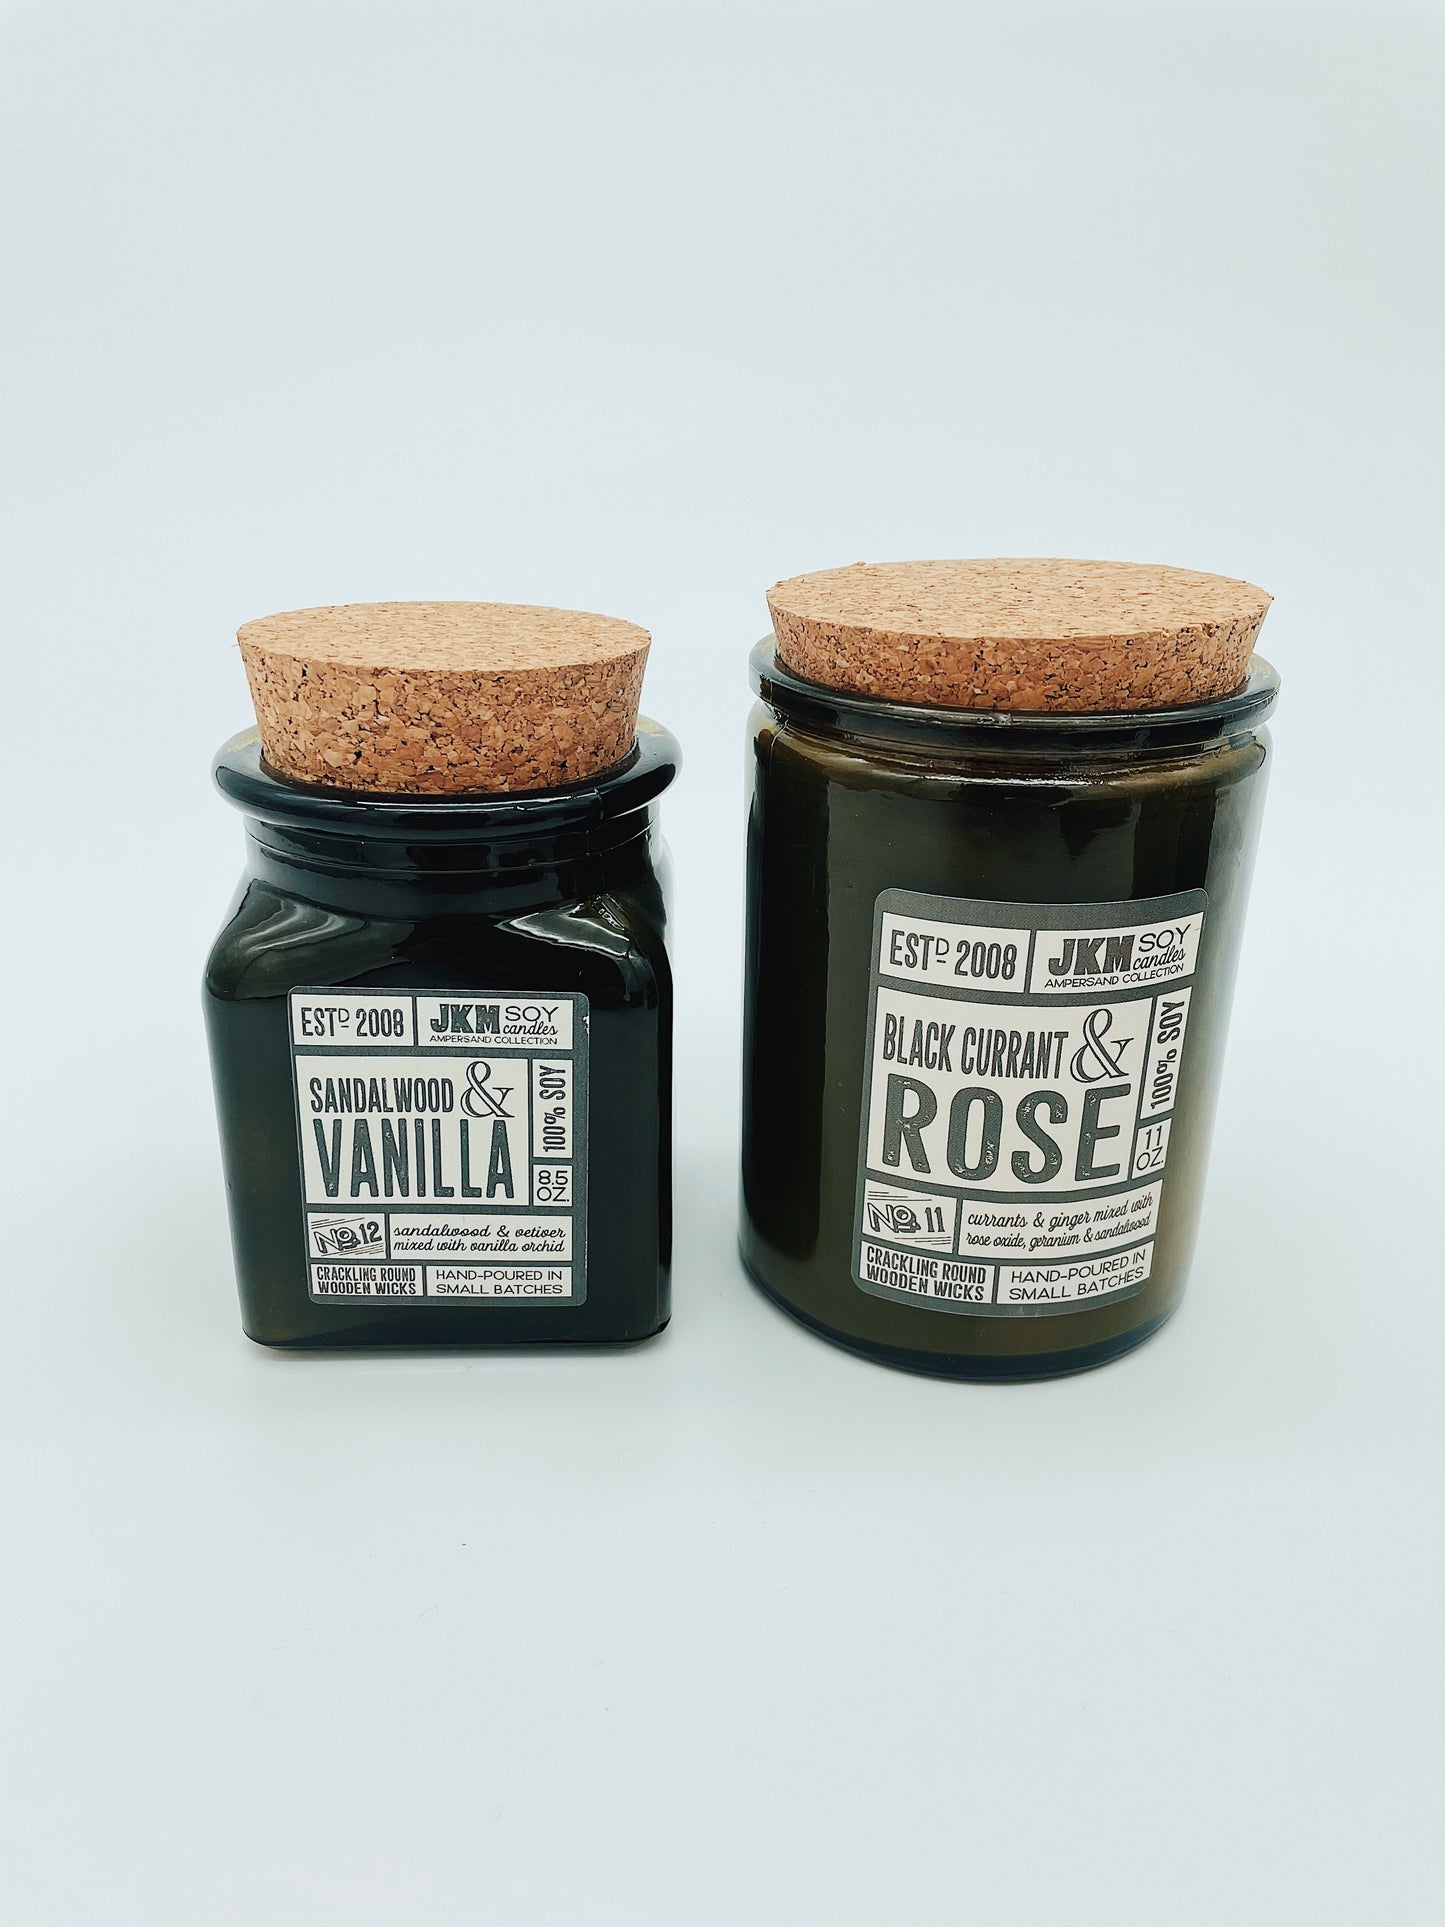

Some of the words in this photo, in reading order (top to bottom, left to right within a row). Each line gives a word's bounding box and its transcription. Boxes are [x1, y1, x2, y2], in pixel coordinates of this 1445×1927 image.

[1138, 924, 1191, 951] SOY
[955, 942, 1017, 980] 2008
[1049, 935, 1135, 975] JKM
[1132, 945, 1186, 970] candles
[1044, 975, 1119, 988] AMPERSAND
[1123, 964, 1183, 983] COLLECTION
[356, 1008, 404, 1037] 2008
[430, 1004, 500, 1034] JKM
[505, 1006, 559, 1022] SOY
[1157, 1001, 1184, 1044] SOY
[430, 1035, 492, 1044] AMPERSAND
[494, 1036, 558, 1045] COLLECTION
[502, 1021, 558, 1036] candles
[883, 1014, 956, 1072] BLACK
[961, 1027, 1068, 1079] CURRANT
[1070, 1009, 1134, 1083] &
[310, 1077, 453, 1113] SANDALWOOD
[460, 1061, 514, 1118] &
[540, 1066, 566, 1100] SOY
[1151, 1049, 1177, 1109] 100%
[543, 1107, 566, 1152] 100%
[882, 1073, 1131, 1184] ROSE
[1146, 1126, 1162, 1149] 11
[313, 1118, 514, 1198] VANILLA
[1137, 1149, 1163, 1170] OZ.
[538, 1170, 568, 1186] 8.5
[536, 1188, 570, 1202] OZ.
[925, 1207, 945, 1233] 11
[968, 1212, 1027, 1227] currants
[1033, 1213, 1045, 1227] &
[1050, 1212, 1091, 1232] ginger
[1093, 1205, 1127, 1222] mixed
[1131, 1192, 1153, 1212] with
[360, 1221, 382, 1245] 12
[394, 1224, 491, 1237] sandalwood
[497, 1226, 510, 1237] &
[516, 1227, 566, 1238] vetiver
[966, 1233, 991, 1246] rose
[993, 1233, 1026, 1249] oxide,
[1029, 1232, 1081, 1251] geranium
[1083, 1228, 1093, 1242] &
[1094, 1212, 1152, 1241] sandalwood
[394, 1239, 434, 1251] mixed
[436, 1239, 467, 1251] with
[470, 1240, 517, 1252] vanilla
[521, 1240, 564, 1252] orchid
[317, 1267, 376, 1281] CRACKLING
[380, 1268, 415, 1282] ROUND
[437, 1270, 542, 1280] HAND-POURED
[548, 1271, 562, 1280] IN
[867, 1246, 939, 1279] CRACKLING
[943, 1264, 985, 1284] ROUND
[1011, 1257, 1129, 1283] HAND-POURED
[1133, 1250, 1145, 1269] IN
[318, 1281, 371, 1294] WOODEN
[375, 1283, 416, 1294] WICKS
[437, 1284, 489, 1294] SMALL
[494, 1285, 562, 1294] BATCHES
[867, 1264, 927, 1293] WOODEN
[935, 1282, 984, 1301] WICKS
[1009, 1288, 1071, 1301] SMALL
[1078, 1266, 1144, 1295] BATCHES
